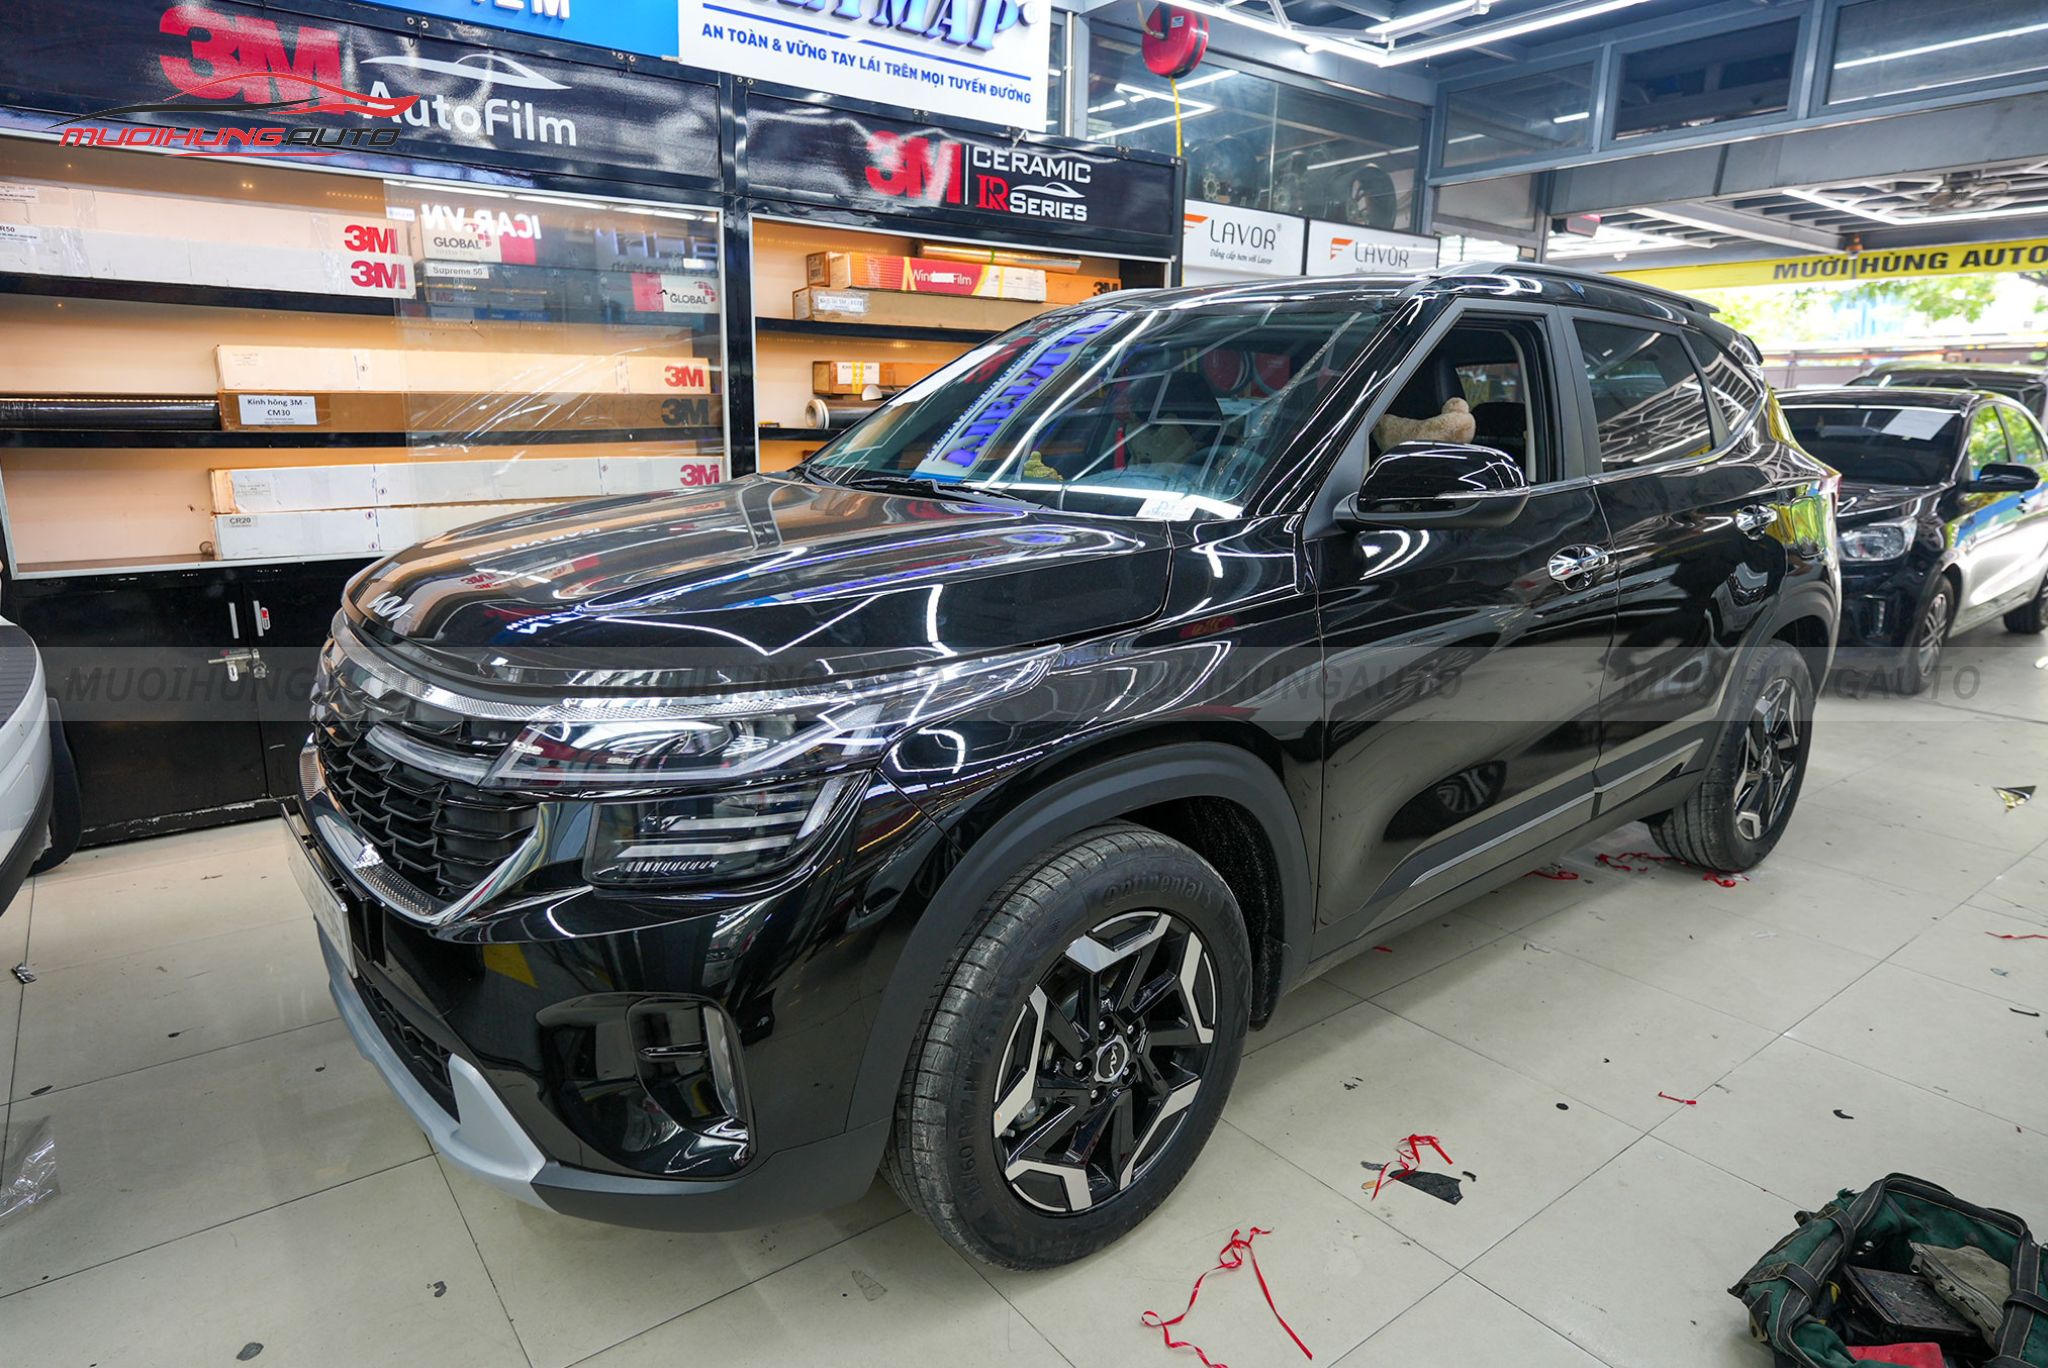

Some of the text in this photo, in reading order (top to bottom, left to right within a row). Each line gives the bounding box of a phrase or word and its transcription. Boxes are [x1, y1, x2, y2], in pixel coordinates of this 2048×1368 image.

[160, 5, 346, 116] 3M
[702, 23, 1032, 104] AN TOÀN & VỮNG TAY LÁI TRÊN MỌI TUYẾN ĐƯỜNG
[363, 81, 577, 146] AutoFilm
[864, 130, 962, 205] 3M
[973, 146, 1092, 184] CERAMIC
[1010, 193, 1088, 222] SERIES
[344, 224, 399, 255] 3M
[433, 236, 482, 250] GLOBAL
[1210, 219, 1276, 251] LAVOR
[1354, 240, 1409, 268] LAVOR
[1773, 245, 2048, 280] MƯỜI HÙNG AUTO
[351, 260, 407, 289] 3M
[433, 267, 483, 278] Supreme 50
[669, 293, 708, 305] GLOBAL
[664, 365, 705, 387] 3M
[267, 409, 291, 417] CM30
[661, 398, 709, 426] 3M
[680, 464, 720, 487] 3M
